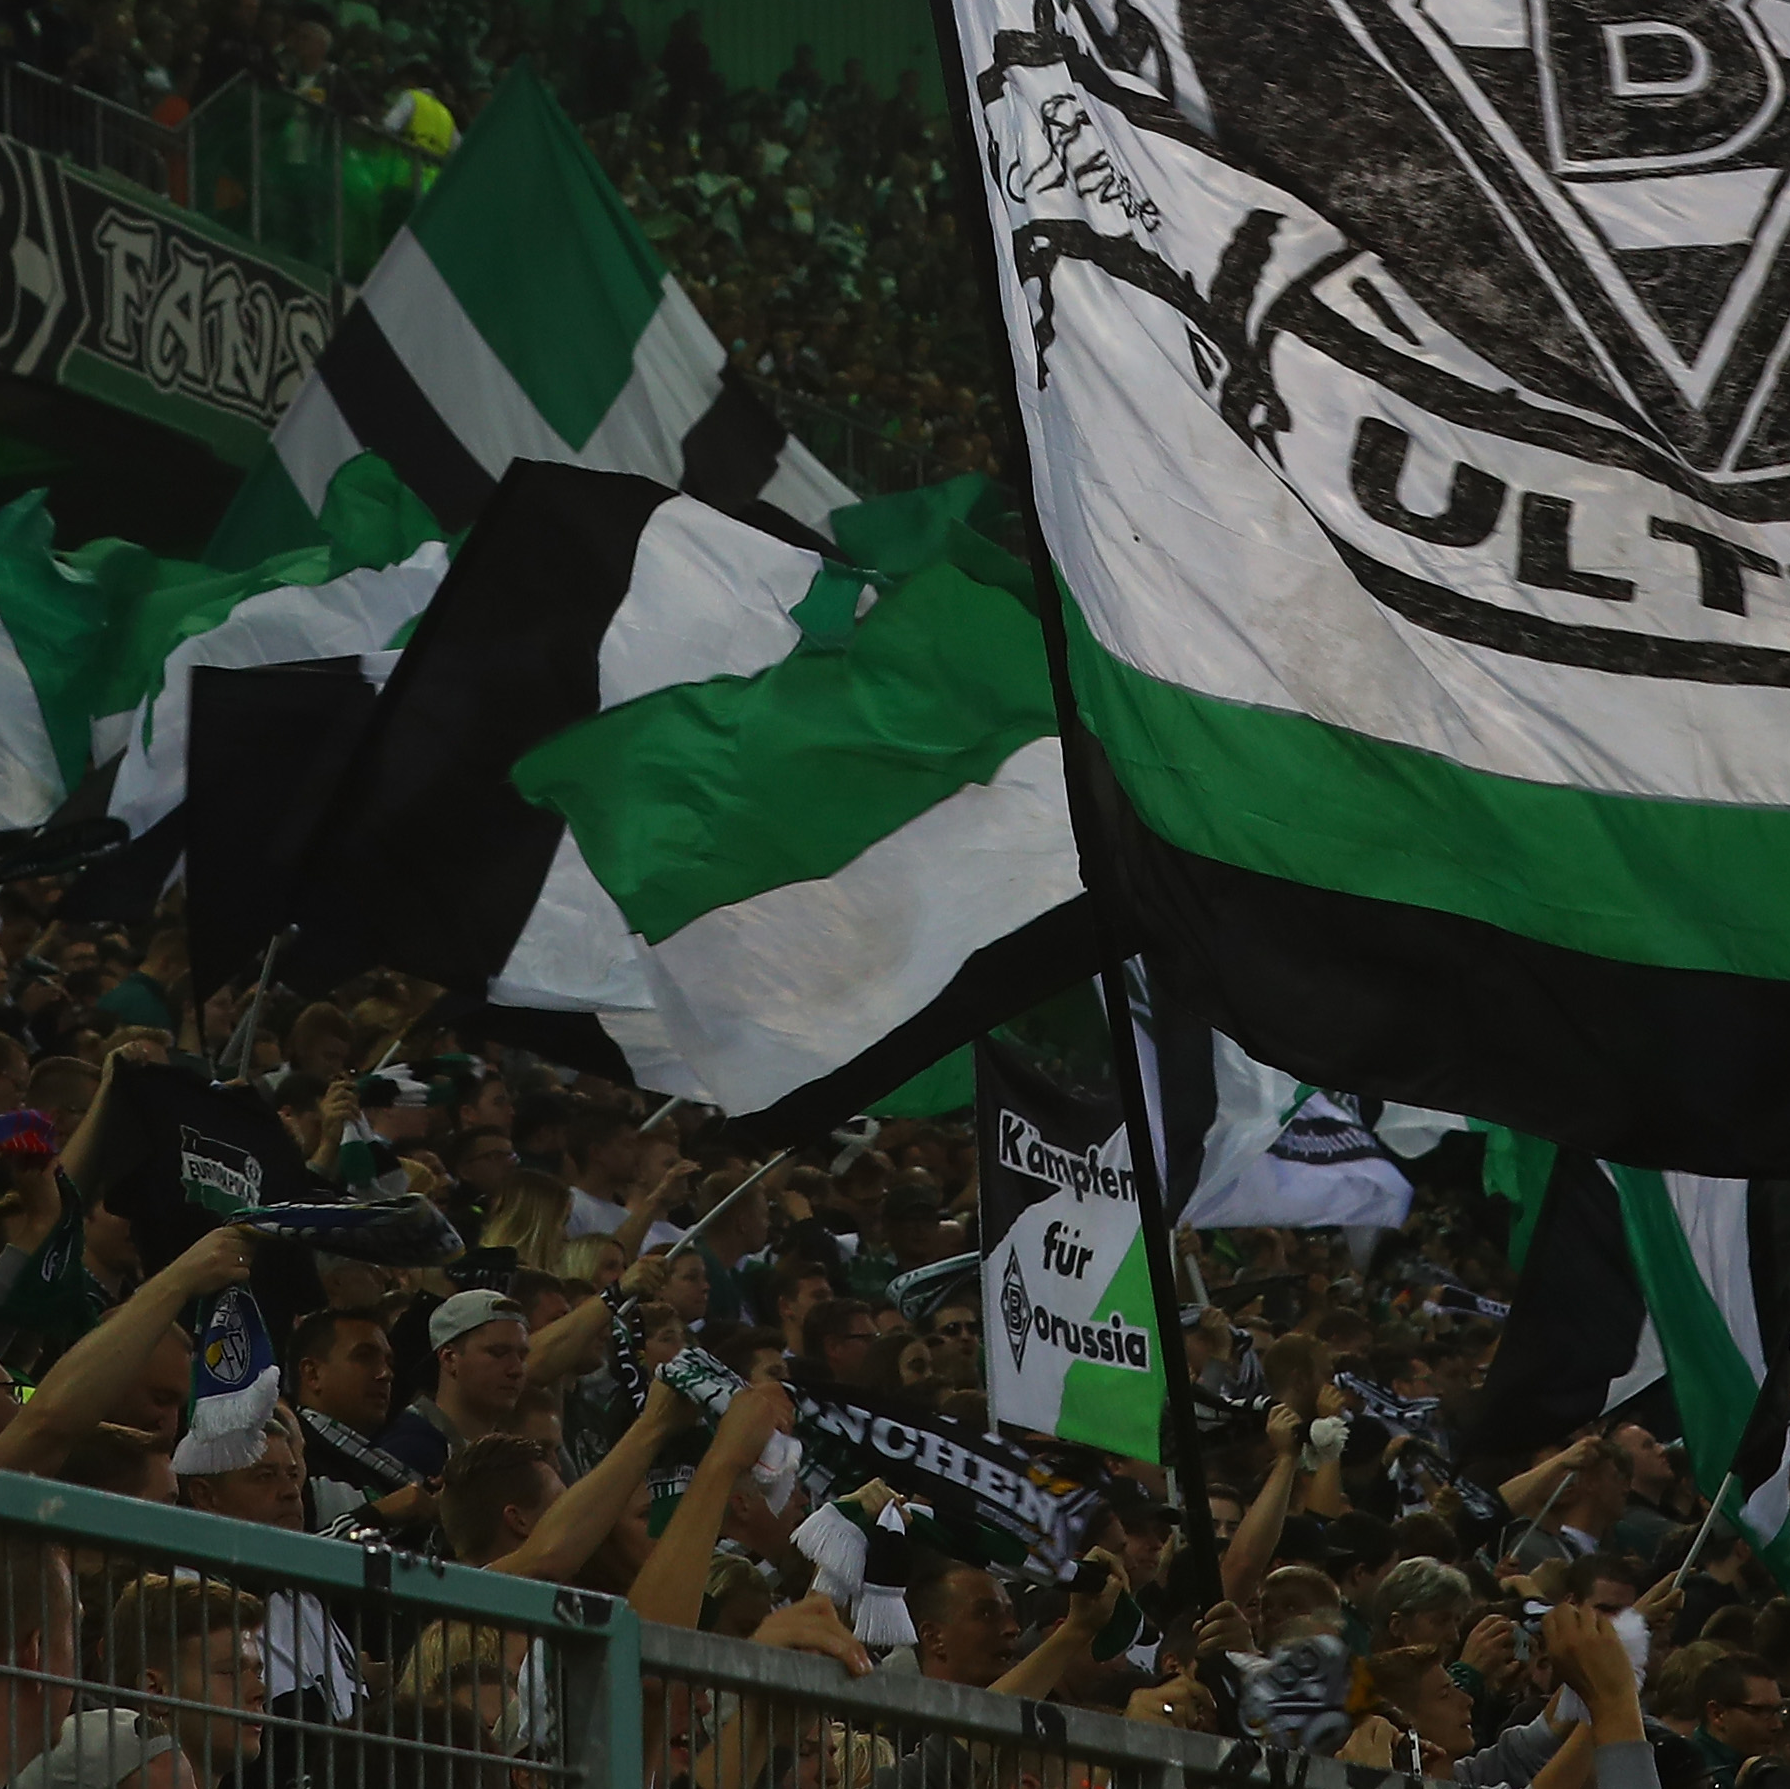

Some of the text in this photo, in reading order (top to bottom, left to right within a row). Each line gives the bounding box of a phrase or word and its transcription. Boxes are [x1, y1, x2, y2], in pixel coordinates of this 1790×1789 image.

[94, 208, 332, 415] FANS
[1001, 1113, 1136, 1202] Kämpfen
[1043, 1219, 1094, 1280] für
